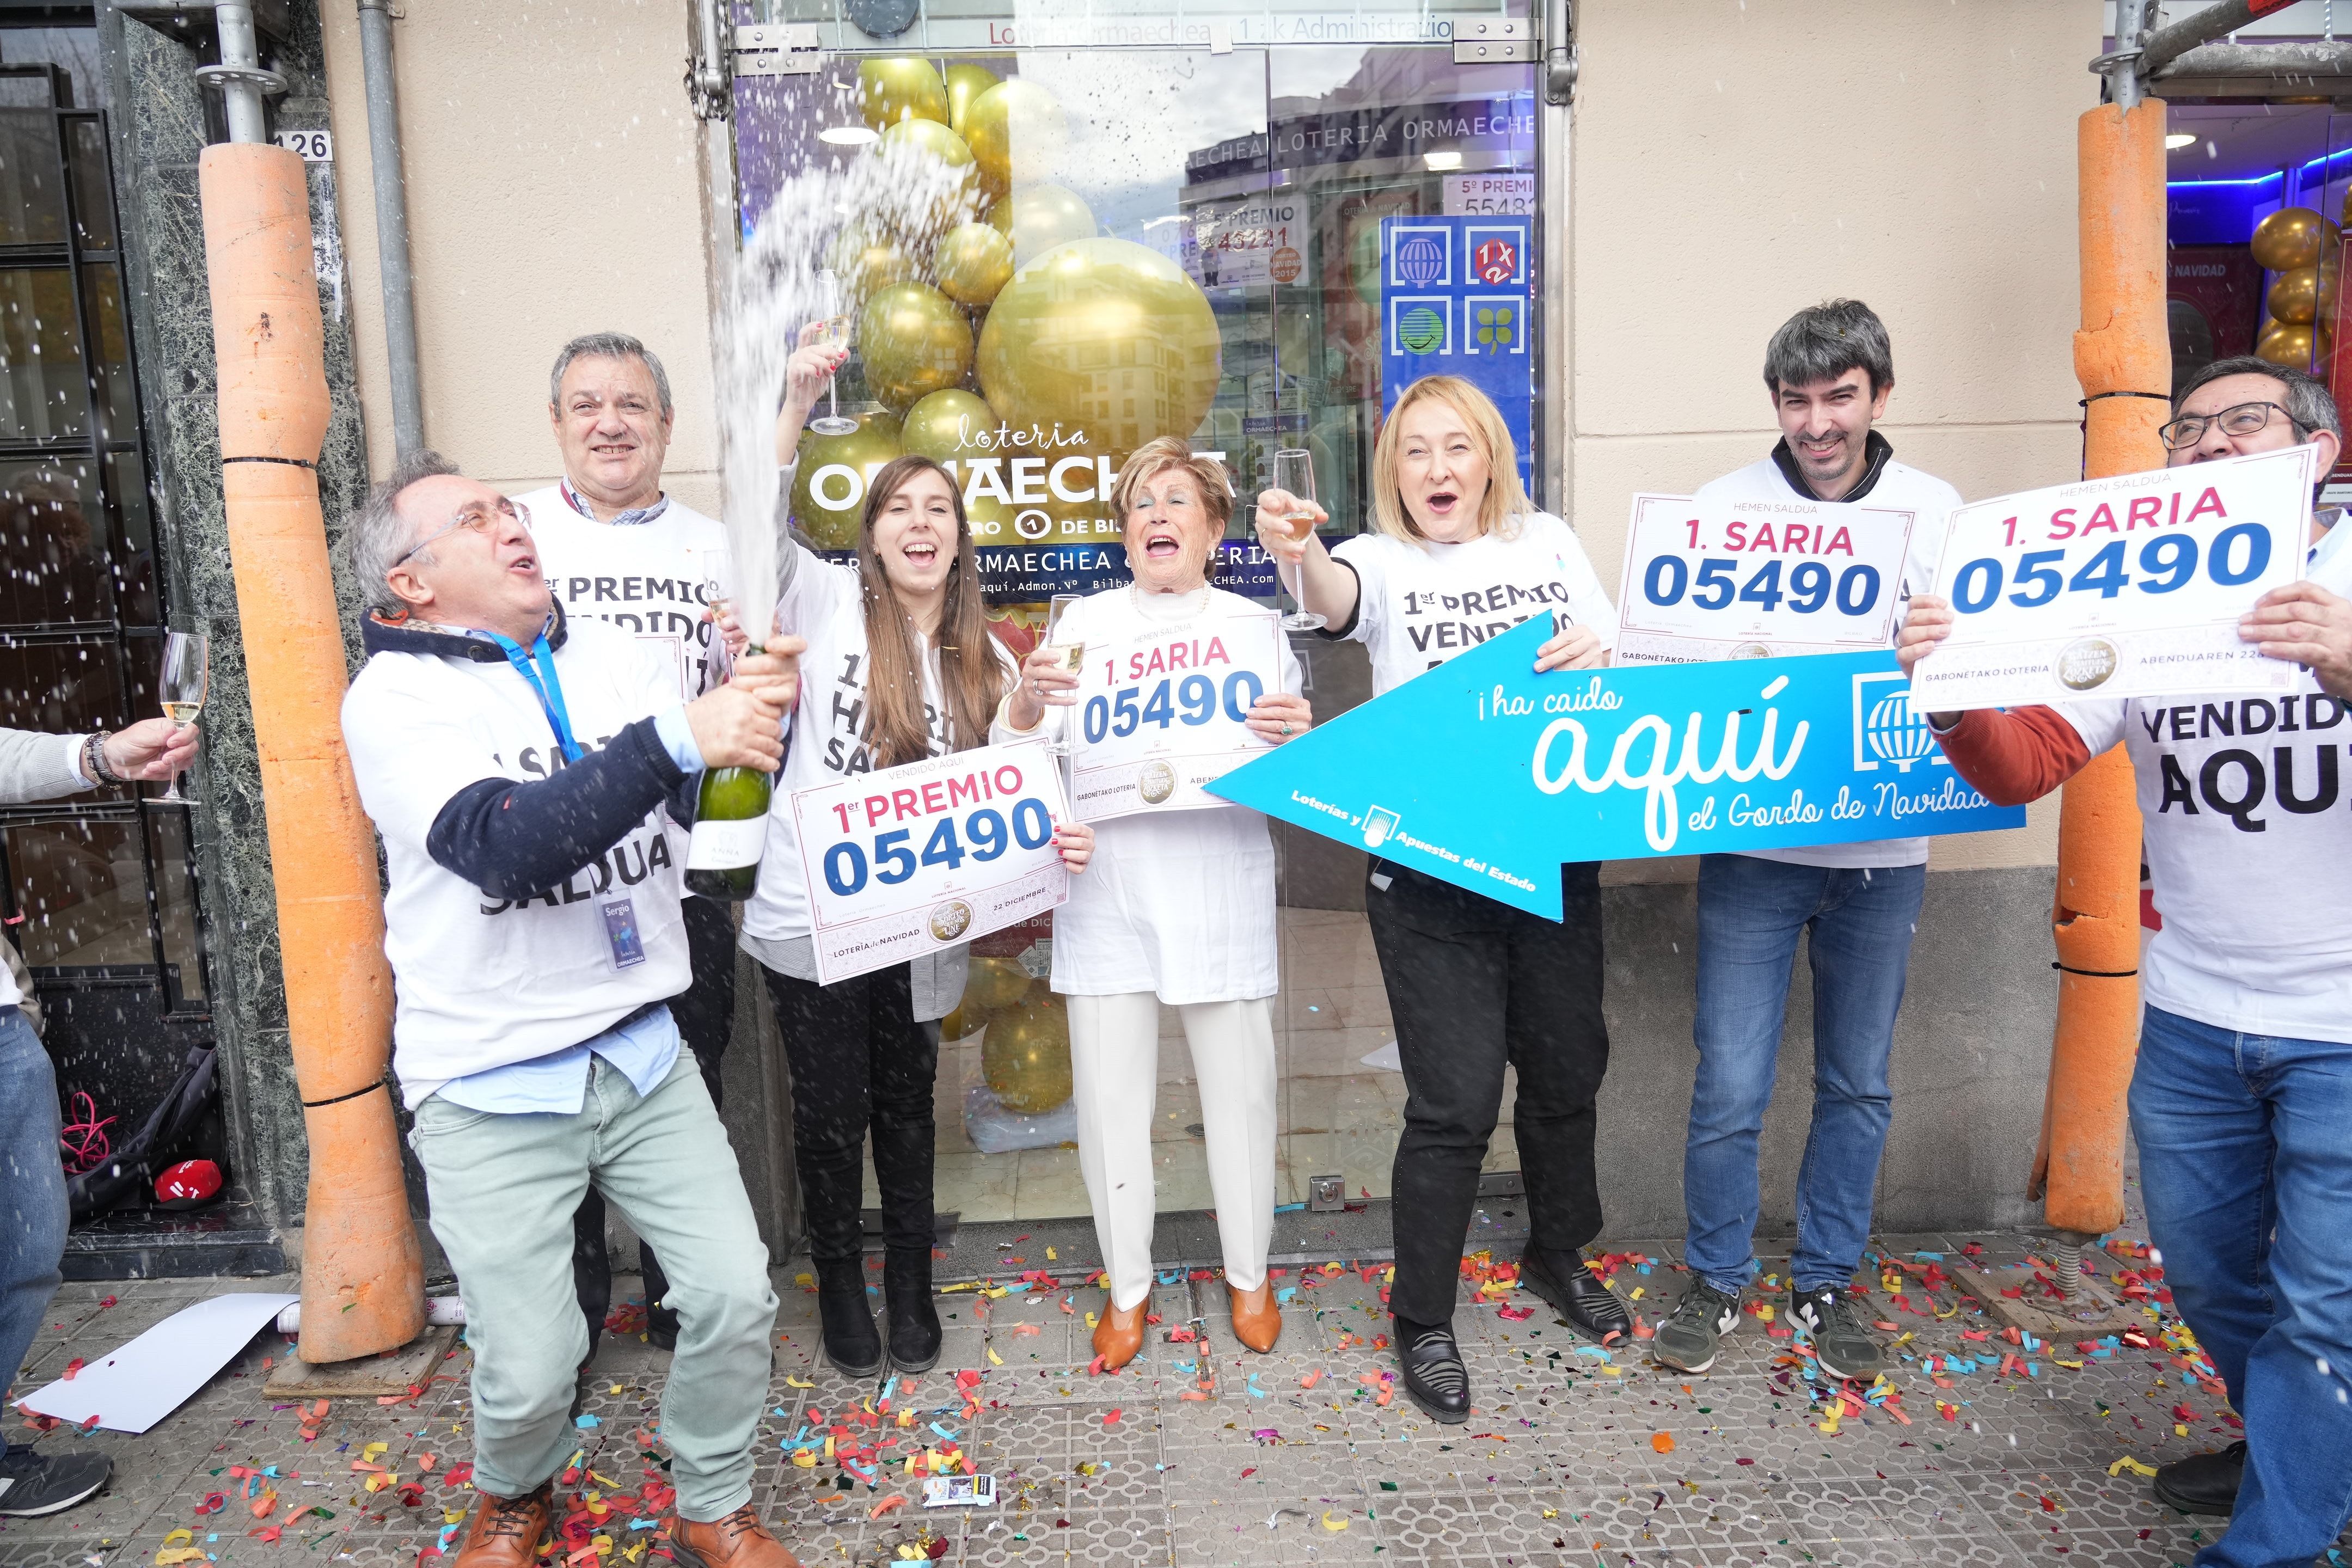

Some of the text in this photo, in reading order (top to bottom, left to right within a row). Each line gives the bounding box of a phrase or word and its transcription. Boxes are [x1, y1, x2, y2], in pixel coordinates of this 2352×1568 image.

[1292, 15, 1451, 39] Administrazio
[1277, 124, 1388, 153] LOTERIA
[1403, 115, 1534, 140] ORMAECHE
[1483, 180, 1532, 193] PREMI
[1228, 206, 1295, 226] PREMIO
[1270, 259, 1301, 268] NAVIDAD
[1275, 269, 1296, 277] 2015
[2175, 264, 2226, 277] NAVIDAD
[953, 413, 1089, 452] loteria
[2060, 473, 2172, 498] HEMEN SALDUA
[1734, 502, 1817, 514] HEMEN SALDUA
[2002, 487, 2228, 547] 1. SARIA
[1061, 520, 1088, 534] DE
[1686, 519, 1854, 556] 1. SARIA
[1951, 522, 2272, 614] 05490
[568, 576, 710, 607] PREMIO
[1404, 581, 1569, 616] 1er PREMIO
[1643, 554, 1881, 616] 05490
[1134, 623, 1192, 644] HEMEN SALDUA
[1105, 636, 1231, 686] 1. SARIA
[1622, 652, 1684, 663] GABONETAKO
[1925, 667, 2000, 682] GABONETAKO
[2002, 665, 2049, 677] LOTERIA
[2140, 650, 2235, 664] ABENDUAREN
[1083, 671, 1264, 745] 05490
[1543, 676, 1624, 713] caido
[888, 757, 964, 780] VENDIDO AQUÍ
[1532, 675, 1810, 853] aquí
[832, 764, 1024, 834] 1er PREMIO
[1077, 787, 1113, 801] GABONETAKO
[1113, 783, 1136, 795] LOTERIA
[2158, 744, 2352, 832] AQU
[1688, 796, 1717, 832] el
[1728, 789, 1824, 828] Gordo
[1830, 785, 1866, 820] de
[823, 797, 1052, 897] 05490
[1291, 789, 1536, 893] Loterías y Apuestas del Estado
[1031, 858, 1048, 867] BILBAO
[605, 904, 630, 916] Sergio
[834, 942, 870, 958] LOTERÍA
[880, 929, 920, 946] NAVIDAD
[1005, 886, 1047, 907] DICIEMBRE
[938, 908, 965, 927] SORTEO
[942, 923, 960, 936] UNE
[617, 955, 645, 967] ORMAECHEA
